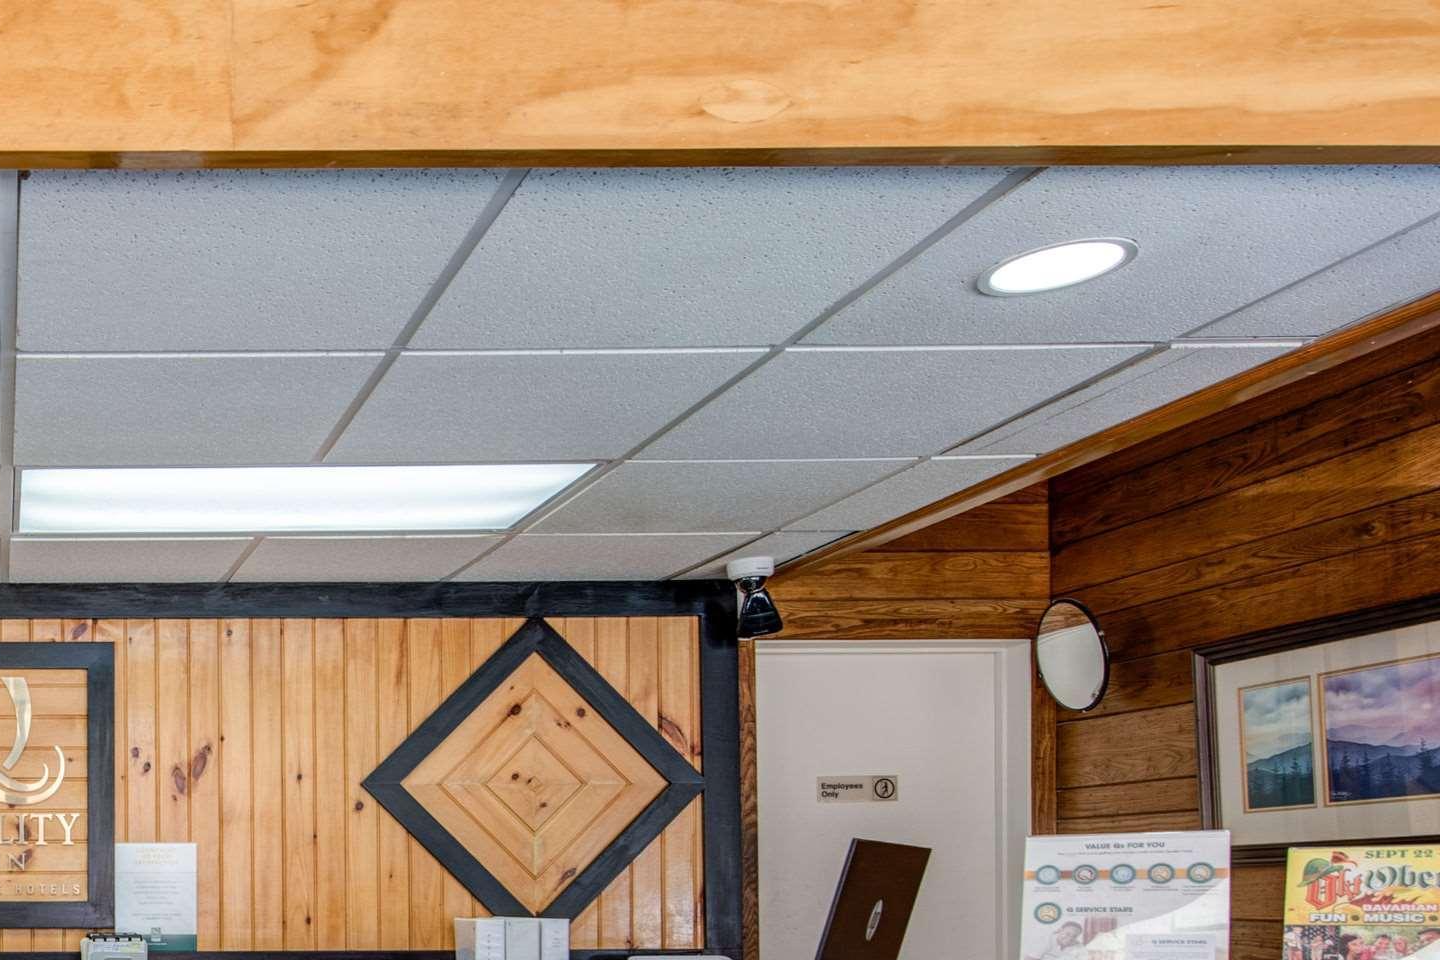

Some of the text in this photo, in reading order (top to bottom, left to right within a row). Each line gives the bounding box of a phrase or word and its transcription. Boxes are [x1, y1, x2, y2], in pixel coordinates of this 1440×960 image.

[821, 782, 863, 790] Employees
[821, 790, 839, 798] Only
[1365, 849, 1433, 859] SEPT 22
[15, 883, 81, 896] HOTELS
[1363, 904, 1437, 912] BAVARIAN
[1310, 913, 1424, 922] FUN MUSIC
